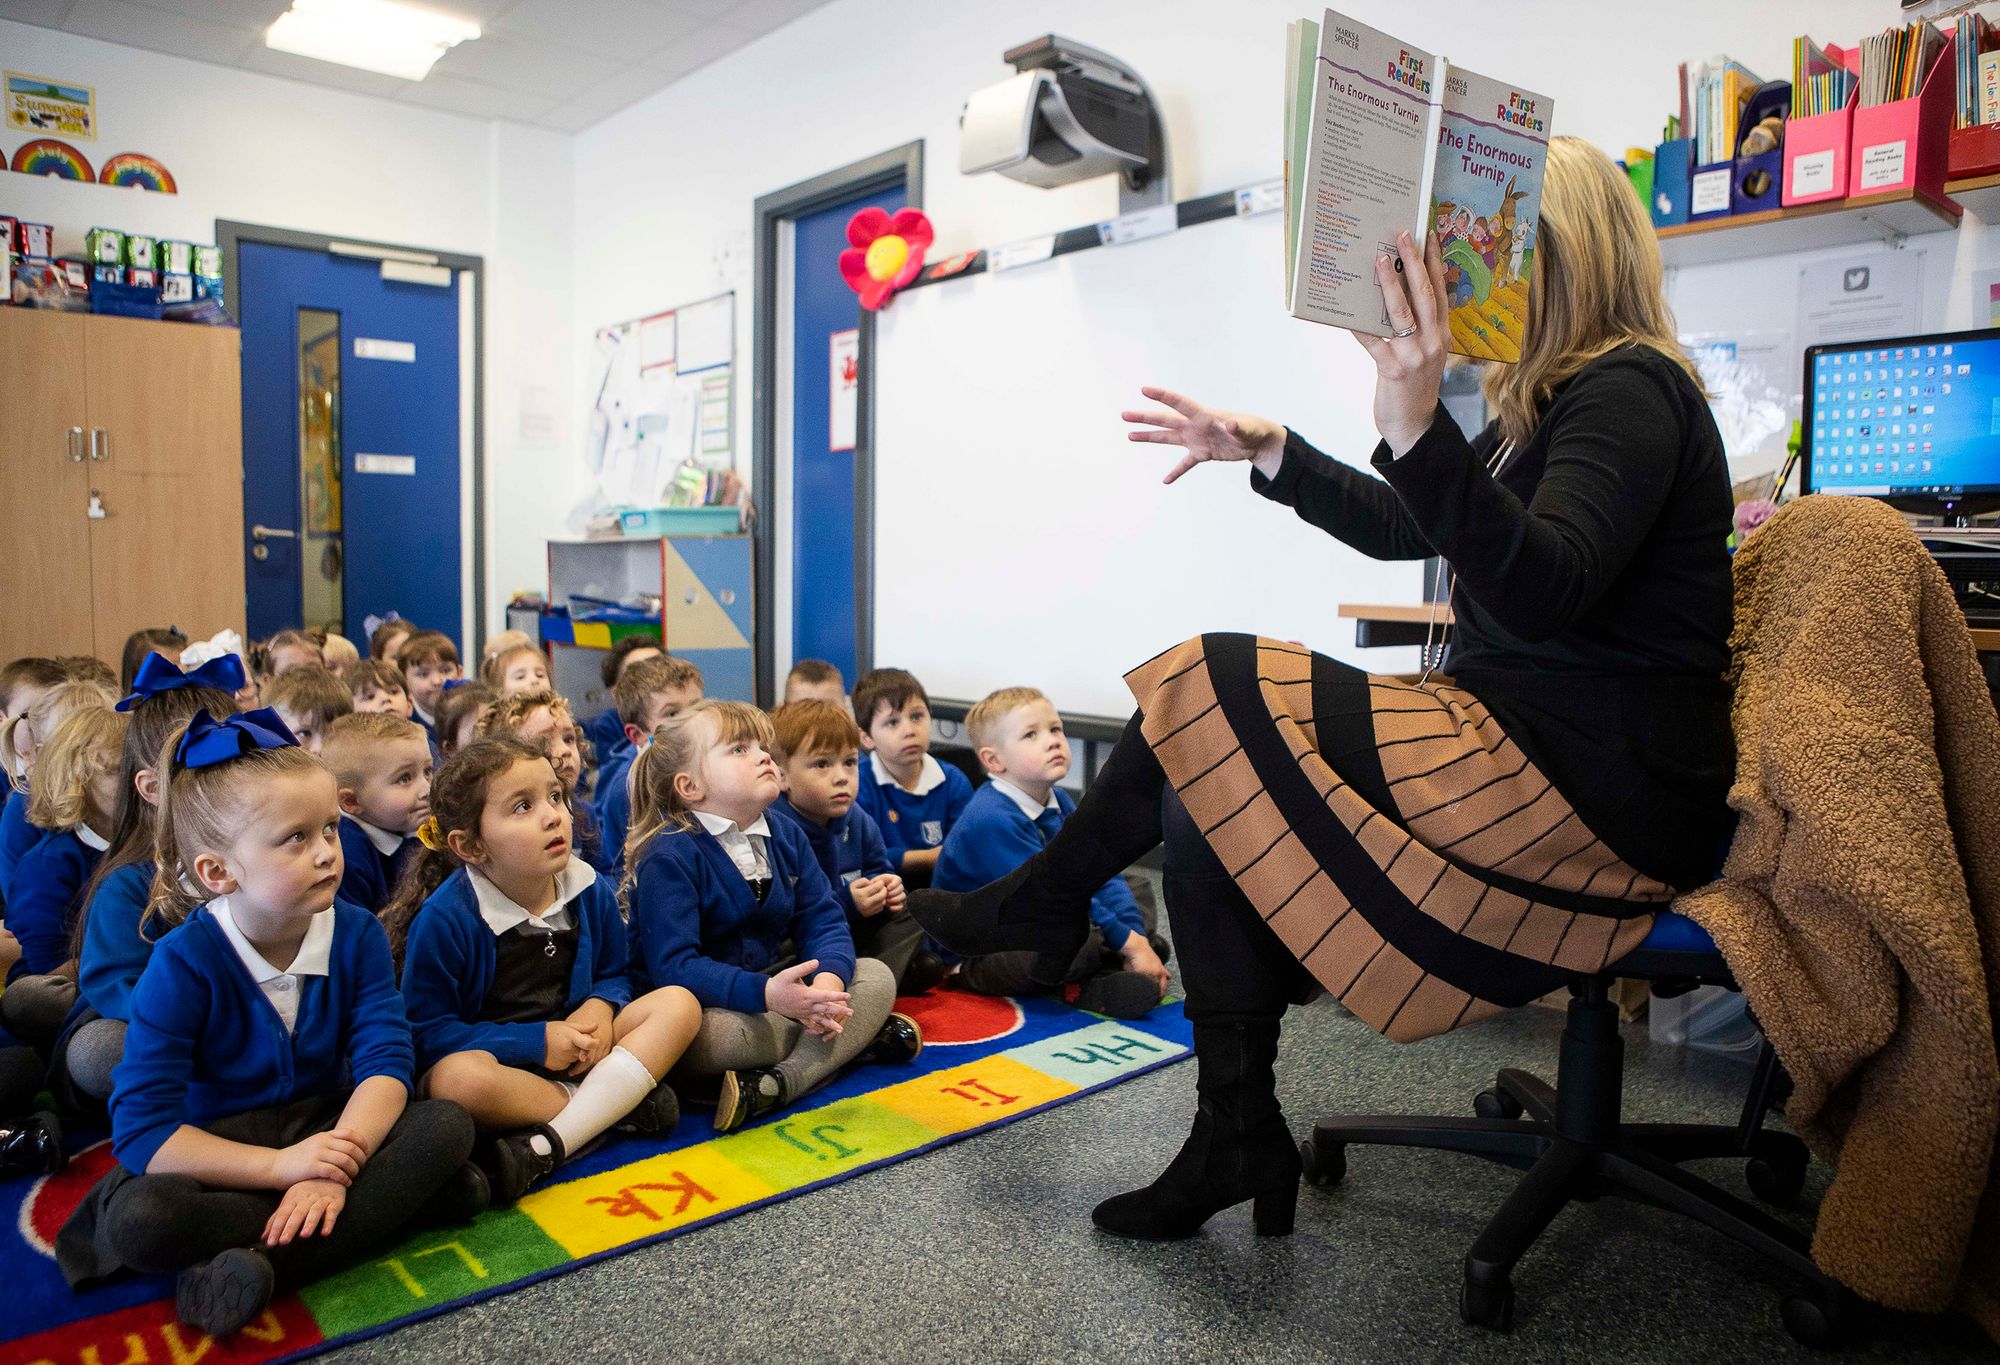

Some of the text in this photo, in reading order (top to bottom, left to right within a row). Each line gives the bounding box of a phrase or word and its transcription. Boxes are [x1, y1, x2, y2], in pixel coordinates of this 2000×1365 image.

[1335, 34, 1359, 51] SPENCER
[1399, 49, 1423, 74] First
[1388, 62, 1430, 94] Readers
[1445, 83, 1467, 97] PENCER
[1328, 76, 1420, 125] The Enormous Turnip
[1509, 91, 1535, 114] First
[1497, 104, 1544, 132] Readers
[1438, 127, 1532, 170] The Enormous
[1462, 155, 1505, 187] Turnip
[1052, 1033, 1164, 1067] Hh
